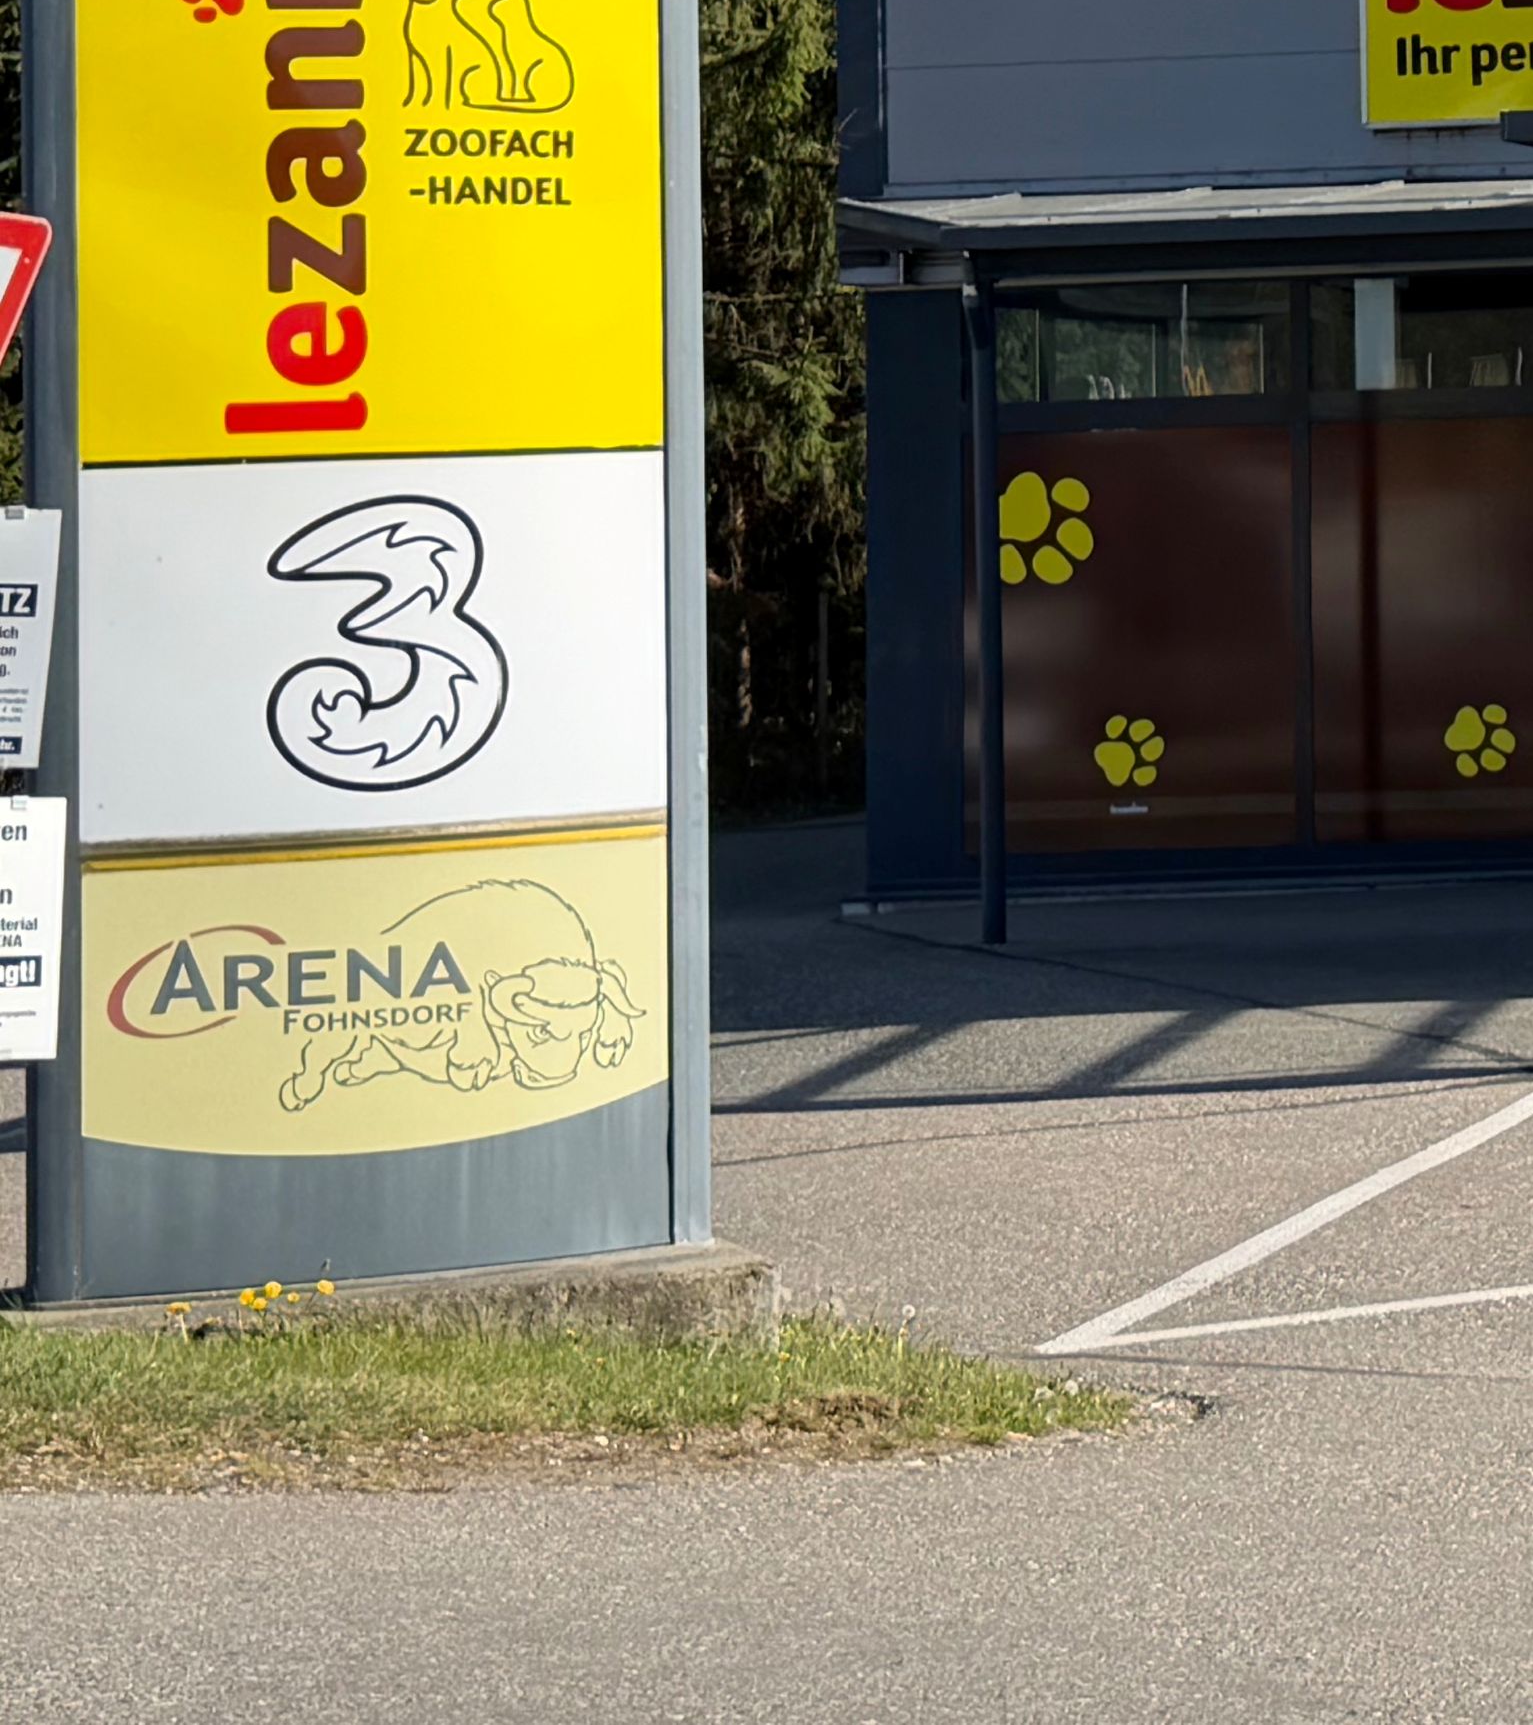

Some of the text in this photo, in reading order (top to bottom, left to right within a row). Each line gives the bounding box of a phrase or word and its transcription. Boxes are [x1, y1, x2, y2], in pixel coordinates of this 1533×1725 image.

[1396, 33, 1462, 77] Ihr
[404, 128, 574, 159] ZOOFACH
[409, 176, 572, 205] -HANDEL
[267, 494, 509, 792] 3
[150, 939, 472, 1016] ARENA
[283, 1001, 474, 1035] FOHNSDORF
